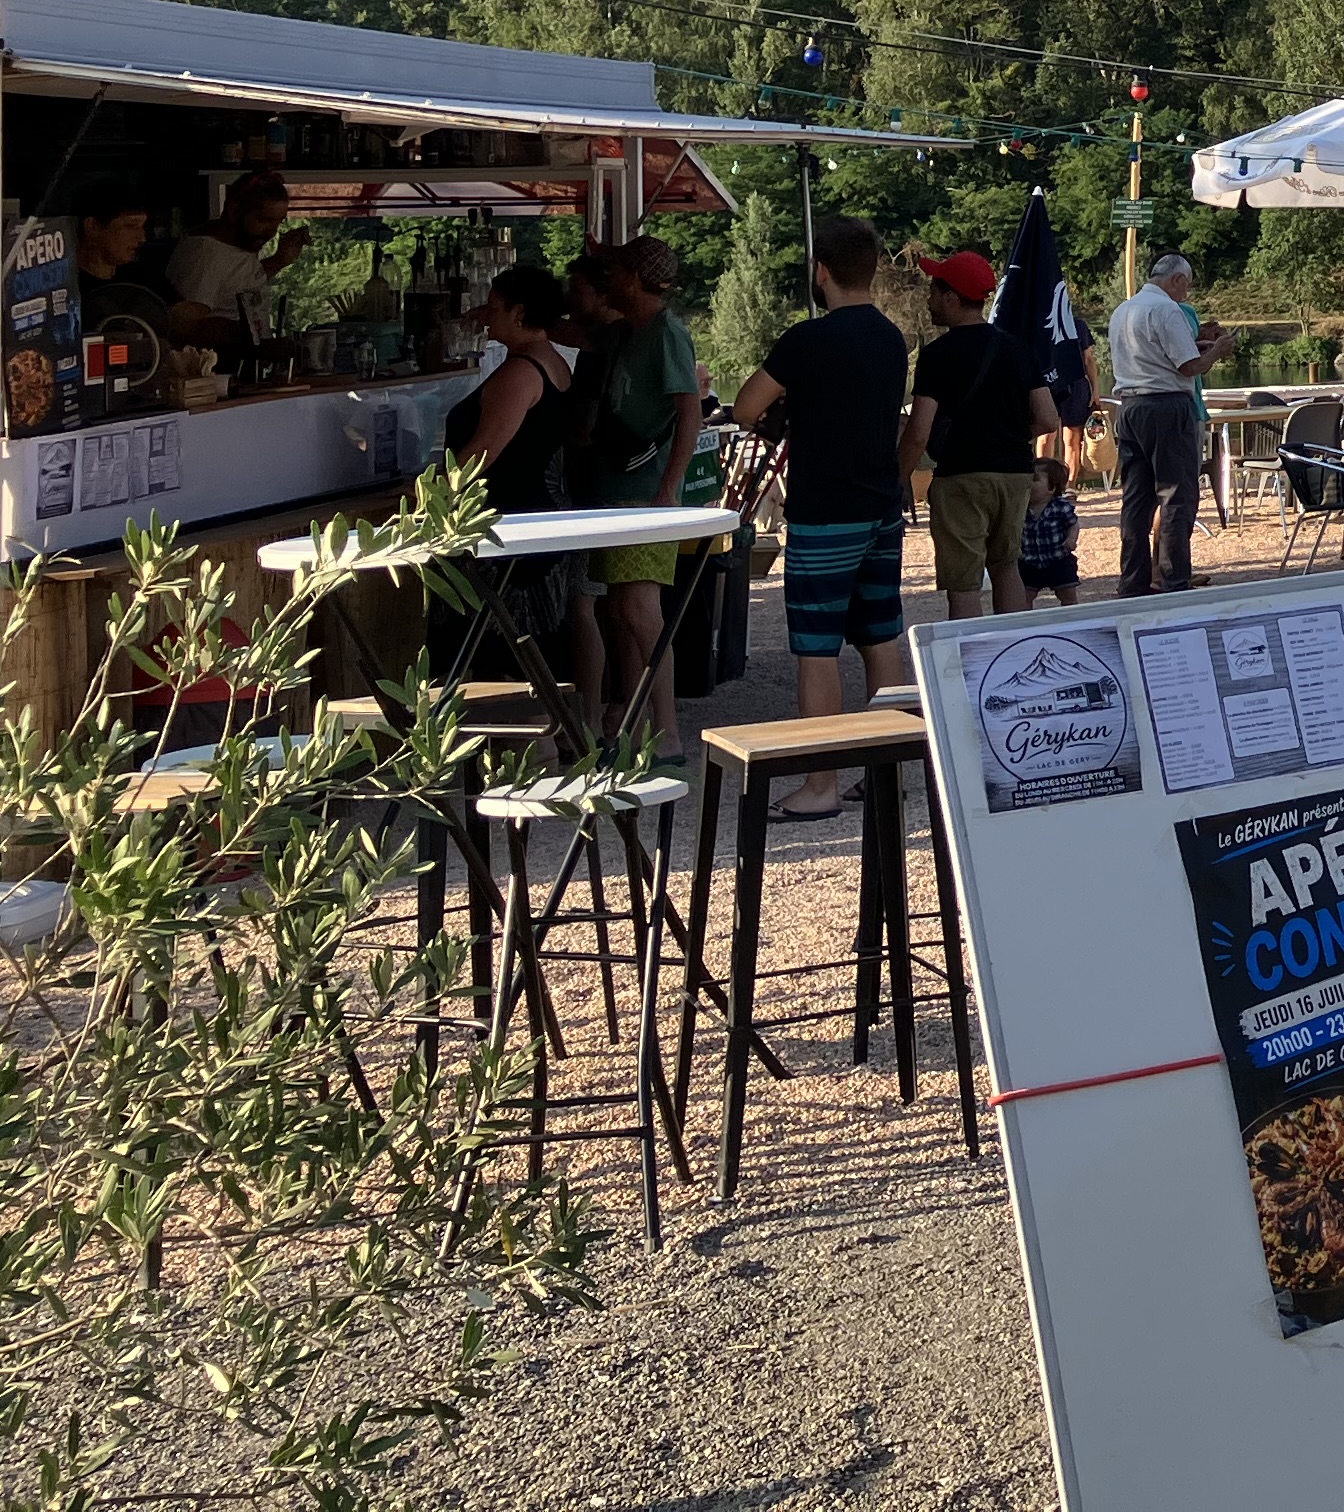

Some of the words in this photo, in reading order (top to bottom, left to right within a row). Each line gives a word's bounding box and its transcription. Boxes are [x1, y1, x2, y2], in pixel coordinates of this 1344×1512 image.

[1005, 721, 1113, 763] Gérykan
[1020, 778, 1060, 791] HORAIRES
[1218, 831, 1233, 849] Le
[1233, 809, 1299, 845] GÉRYKAN
[1253, 1004, 1294, 1033] JEUDI
[1297, 996, 1315, 1016] 16
[1262, 1028, 1314, 1063] 20h00
[1284, 1059, 1312, 1084] LAC
[1316, 1051, 1336, 1072] DE
